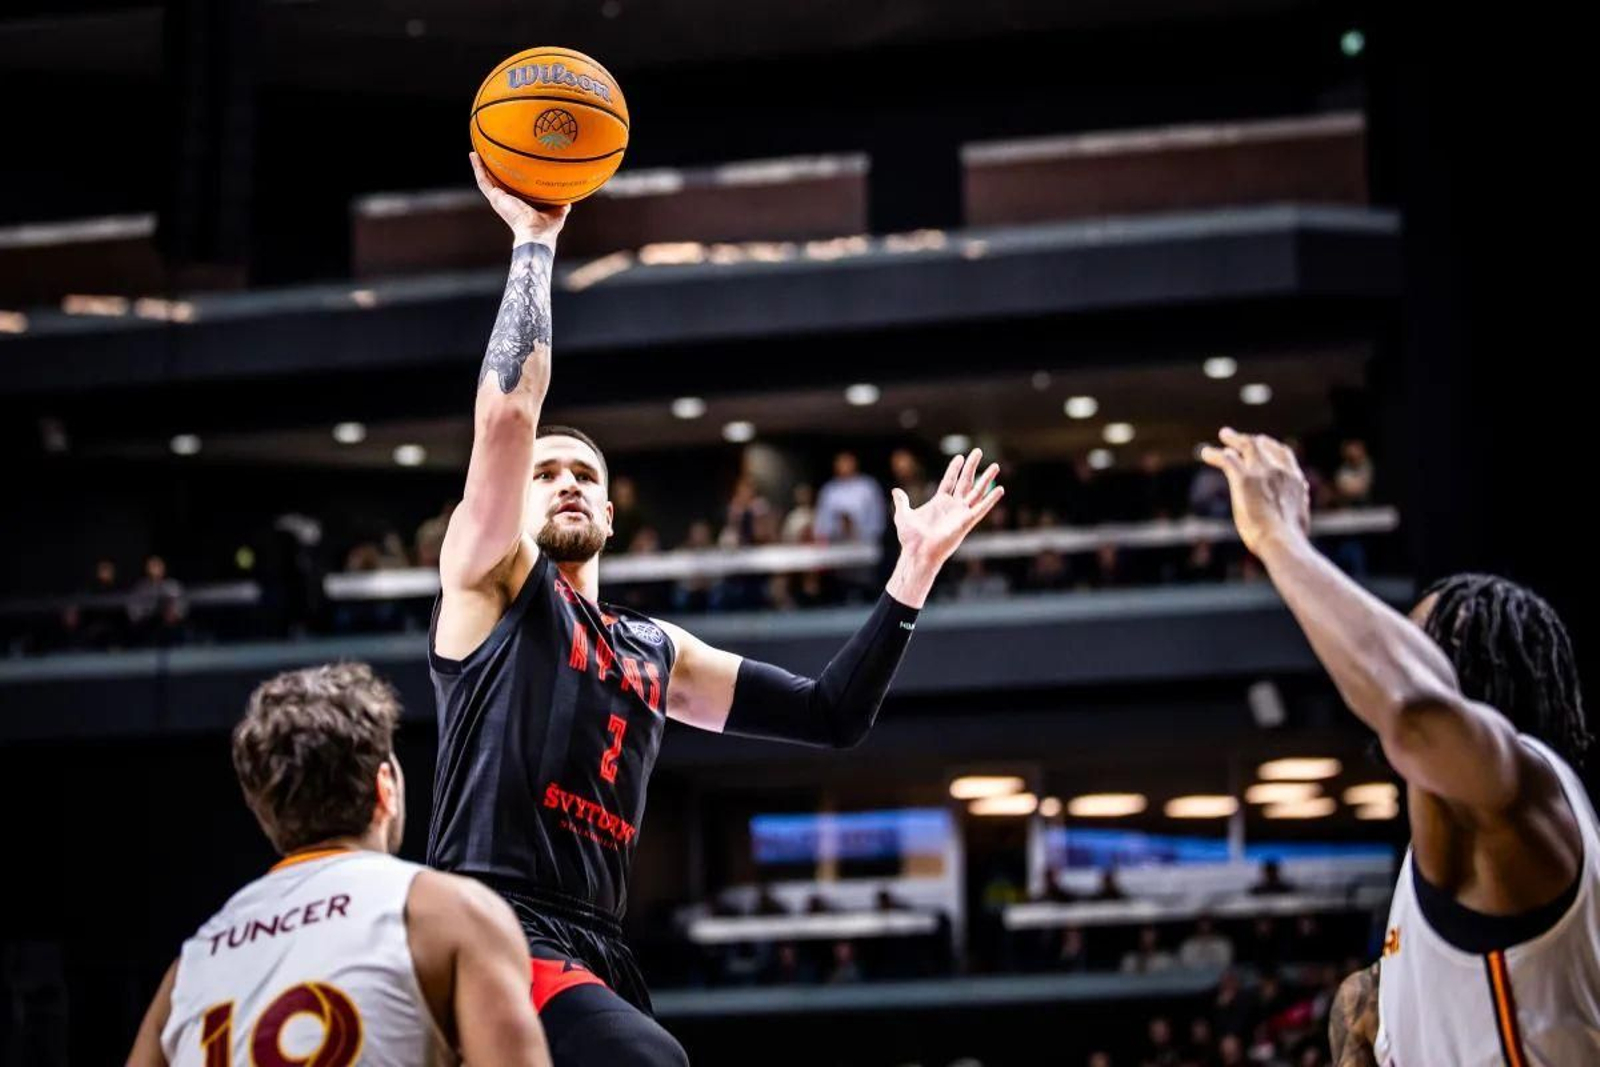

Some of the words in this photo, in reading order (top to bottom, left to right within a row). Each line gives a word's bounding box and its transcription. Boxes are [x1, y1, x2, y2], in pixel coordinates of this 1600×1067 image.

[507, 62, 612, 103] Wilson
[600, 714, 627, 784] 2
[209, 893, 351, 956] TUNCER
[200, 981, 364, 1067] 19
